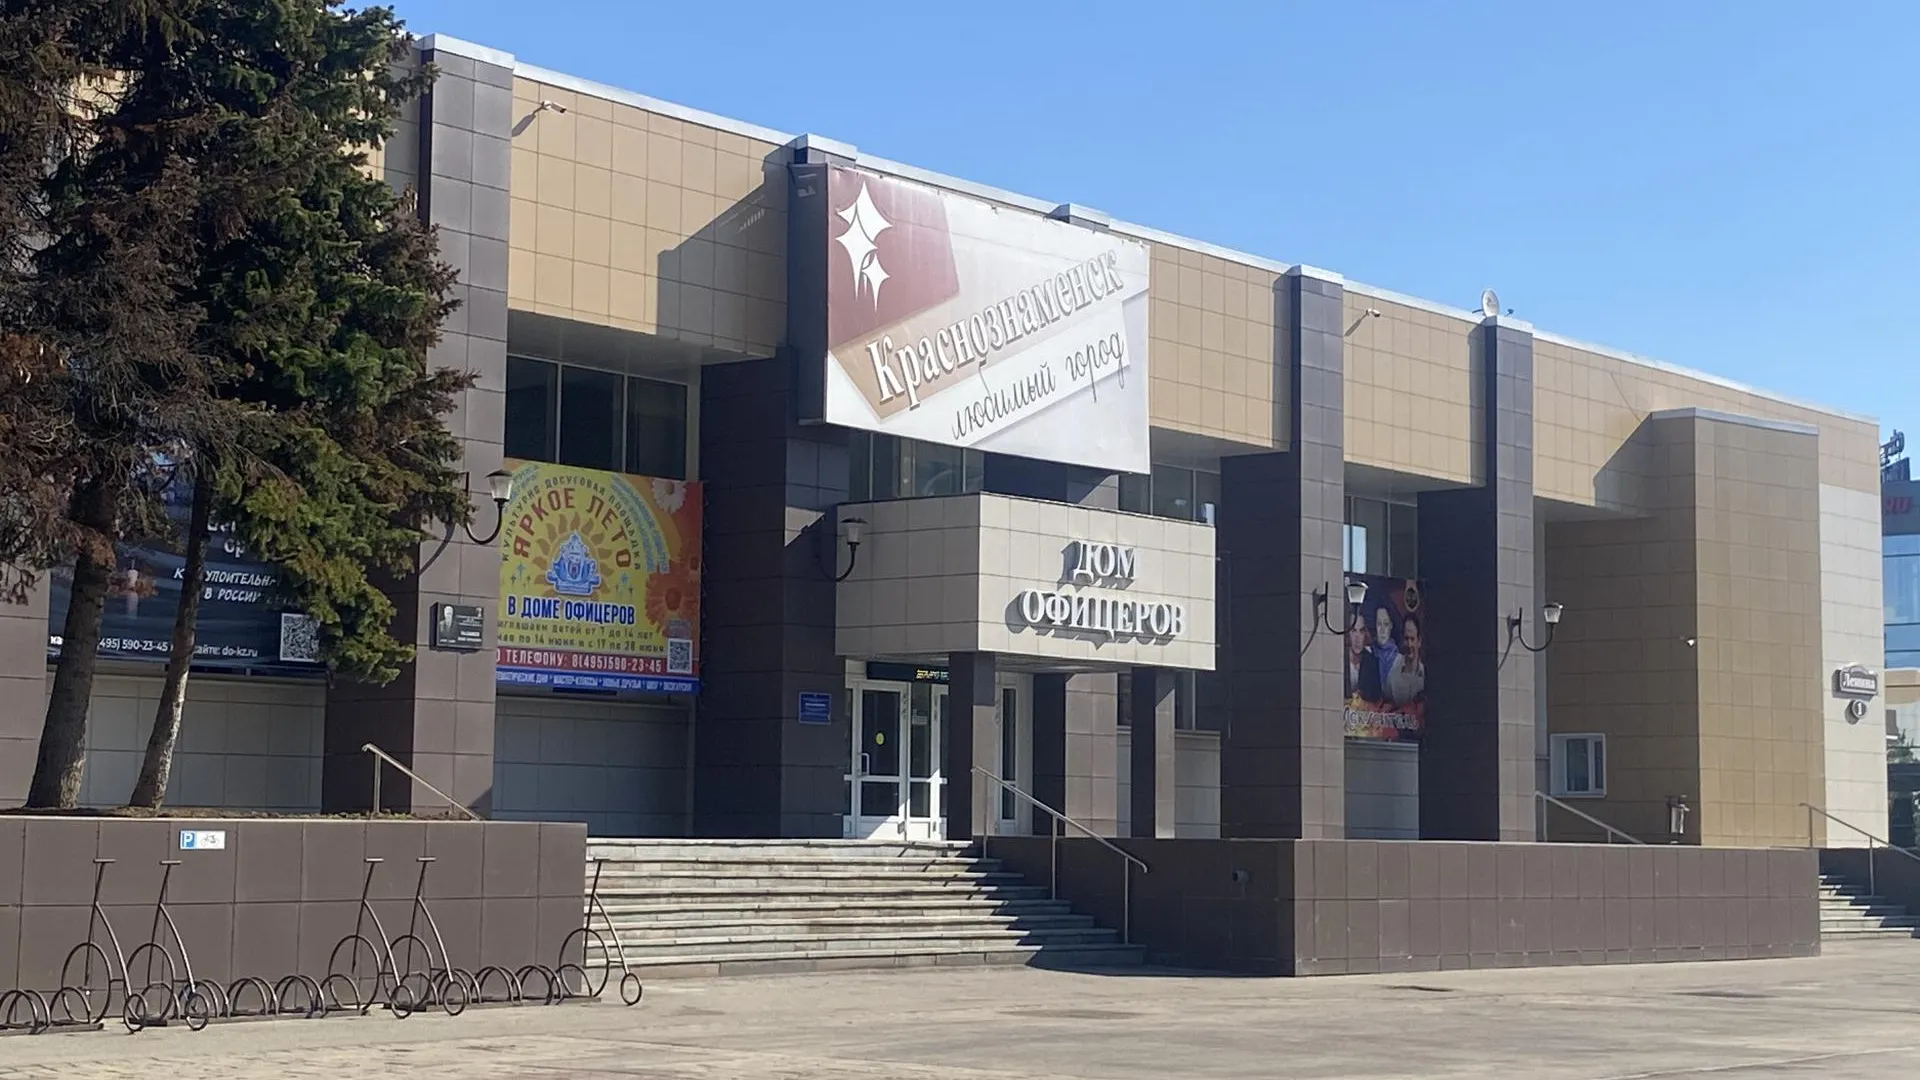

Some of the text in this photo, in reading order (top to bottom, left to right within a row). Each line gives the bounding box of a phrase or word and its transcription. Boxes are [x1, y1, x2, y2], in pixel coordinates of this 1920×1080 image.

[866, 249, 1124, 411] Краснознаменск
[952, 332, 1124, 440] любимый город
[513, 488, 576, 558] ЯРКОЕ
[586, 494, 632, 568] ЛЕТО
[1073, 541, 1139, 583] ДОМ
[204, 587, 213, 600] В
[508, 596, 635, 625] В ДОМЕ ОФИЦЕРОВ
[498, 620, 548, 632] иглашаем
[1022, 589, 1187, 640] ОФИЦЕРОВ
[122, 639, 168, 652] 590-23-45
[506, 649, 567, 667] ТЕЛЕФОНУ:
[572, 655, 662, 673] 8(495)590-23-45
